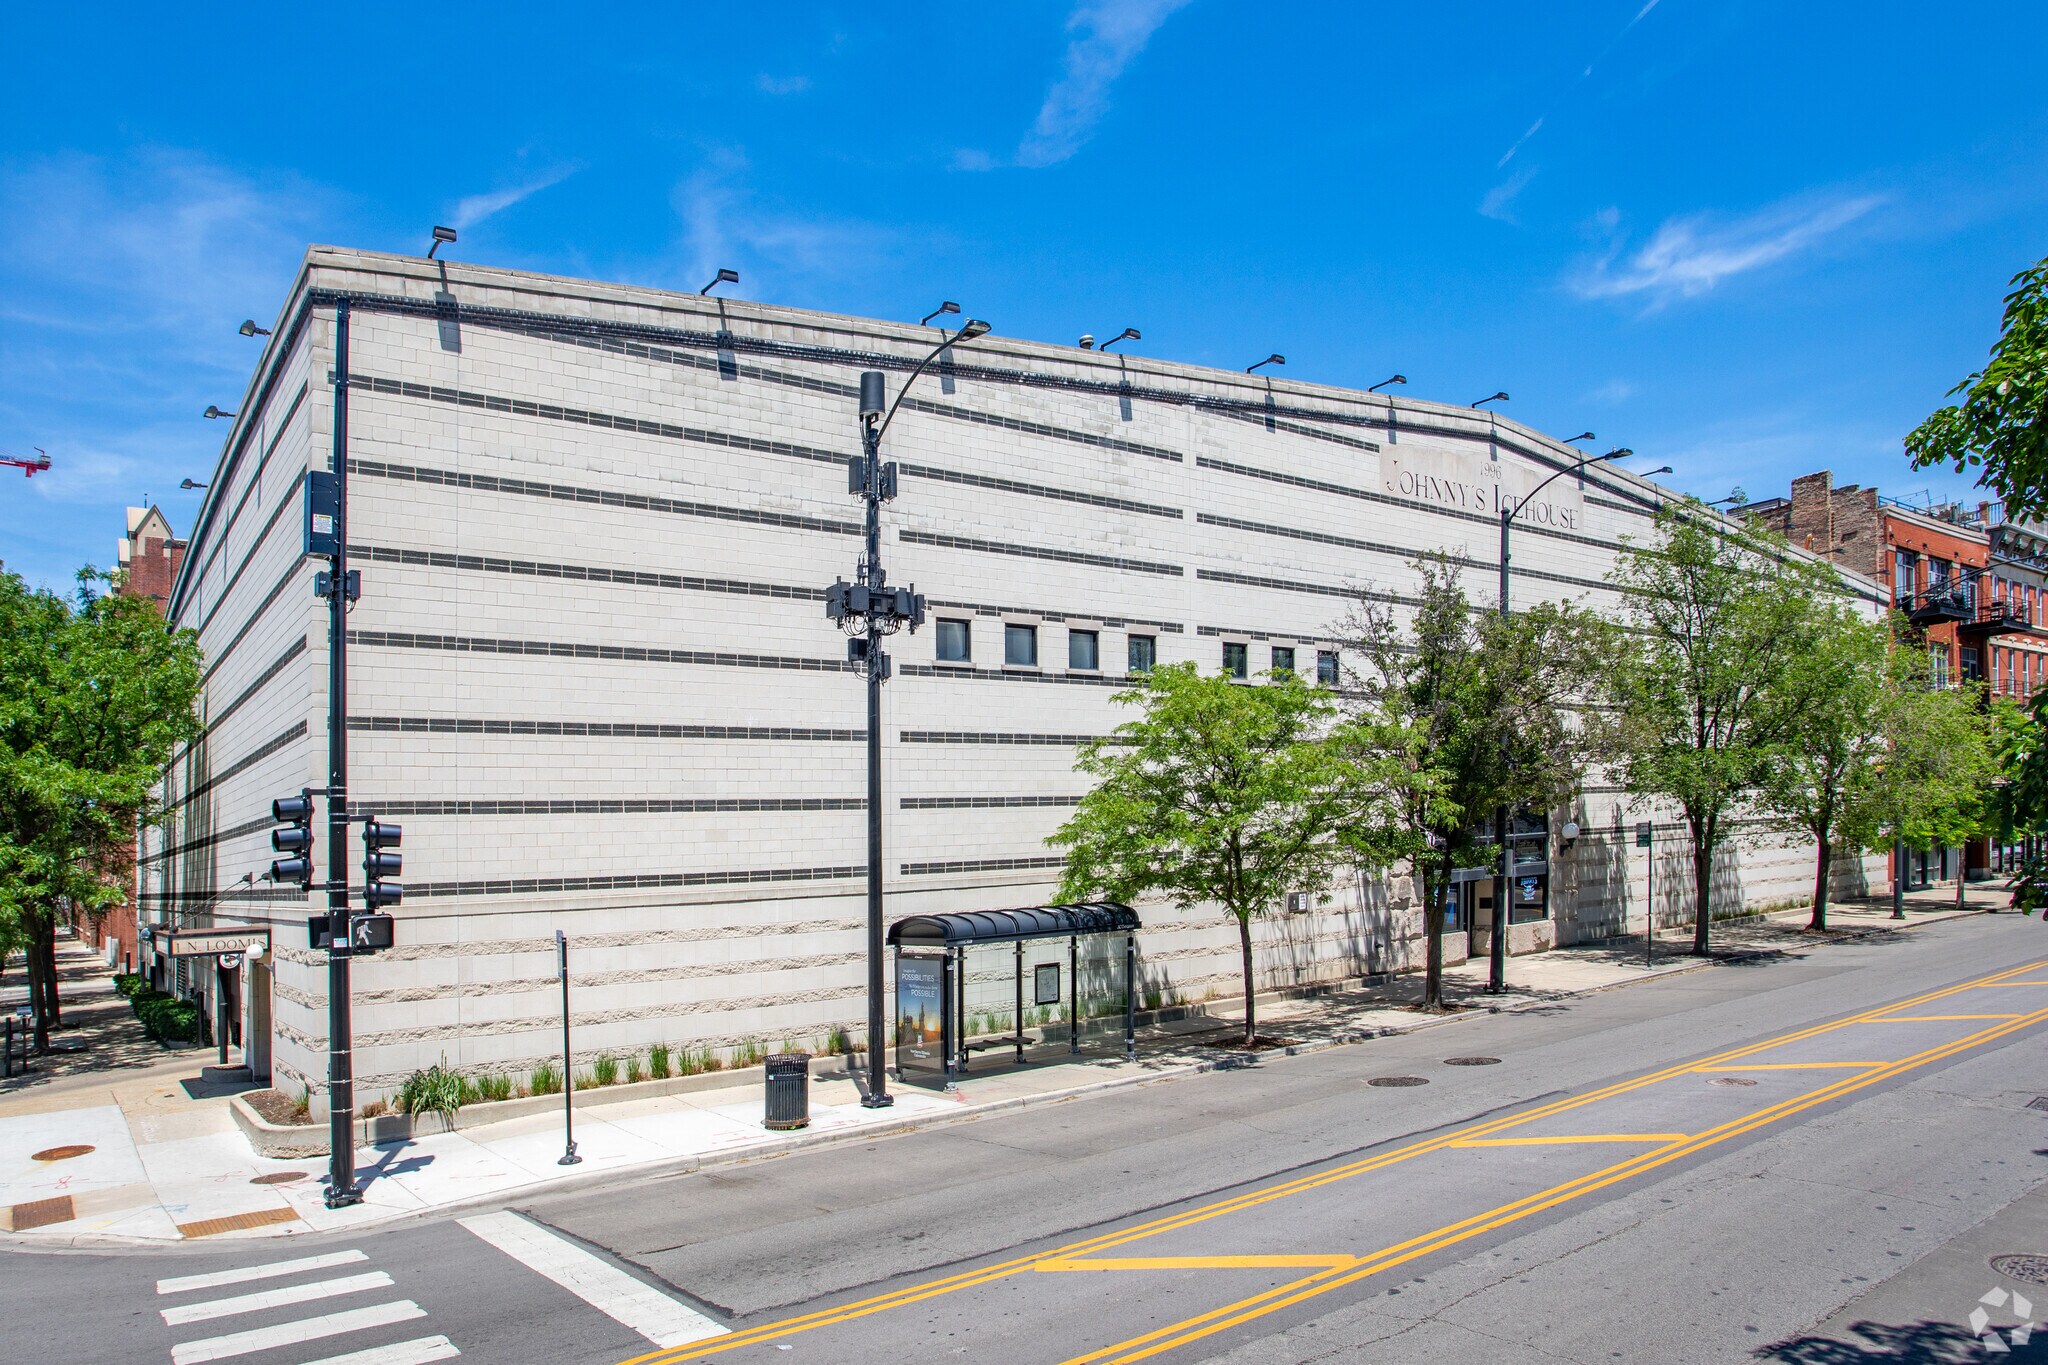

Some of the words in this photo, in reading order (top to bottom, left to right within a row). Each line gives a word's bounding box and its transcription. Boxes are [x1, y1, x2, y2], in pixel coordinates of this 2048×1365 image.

[1481, 461, 1501, 479] 1996
[1386, 460, 1486, 511] JOHNNY'S
[911, 989, 936, 998] POSSIBLE
